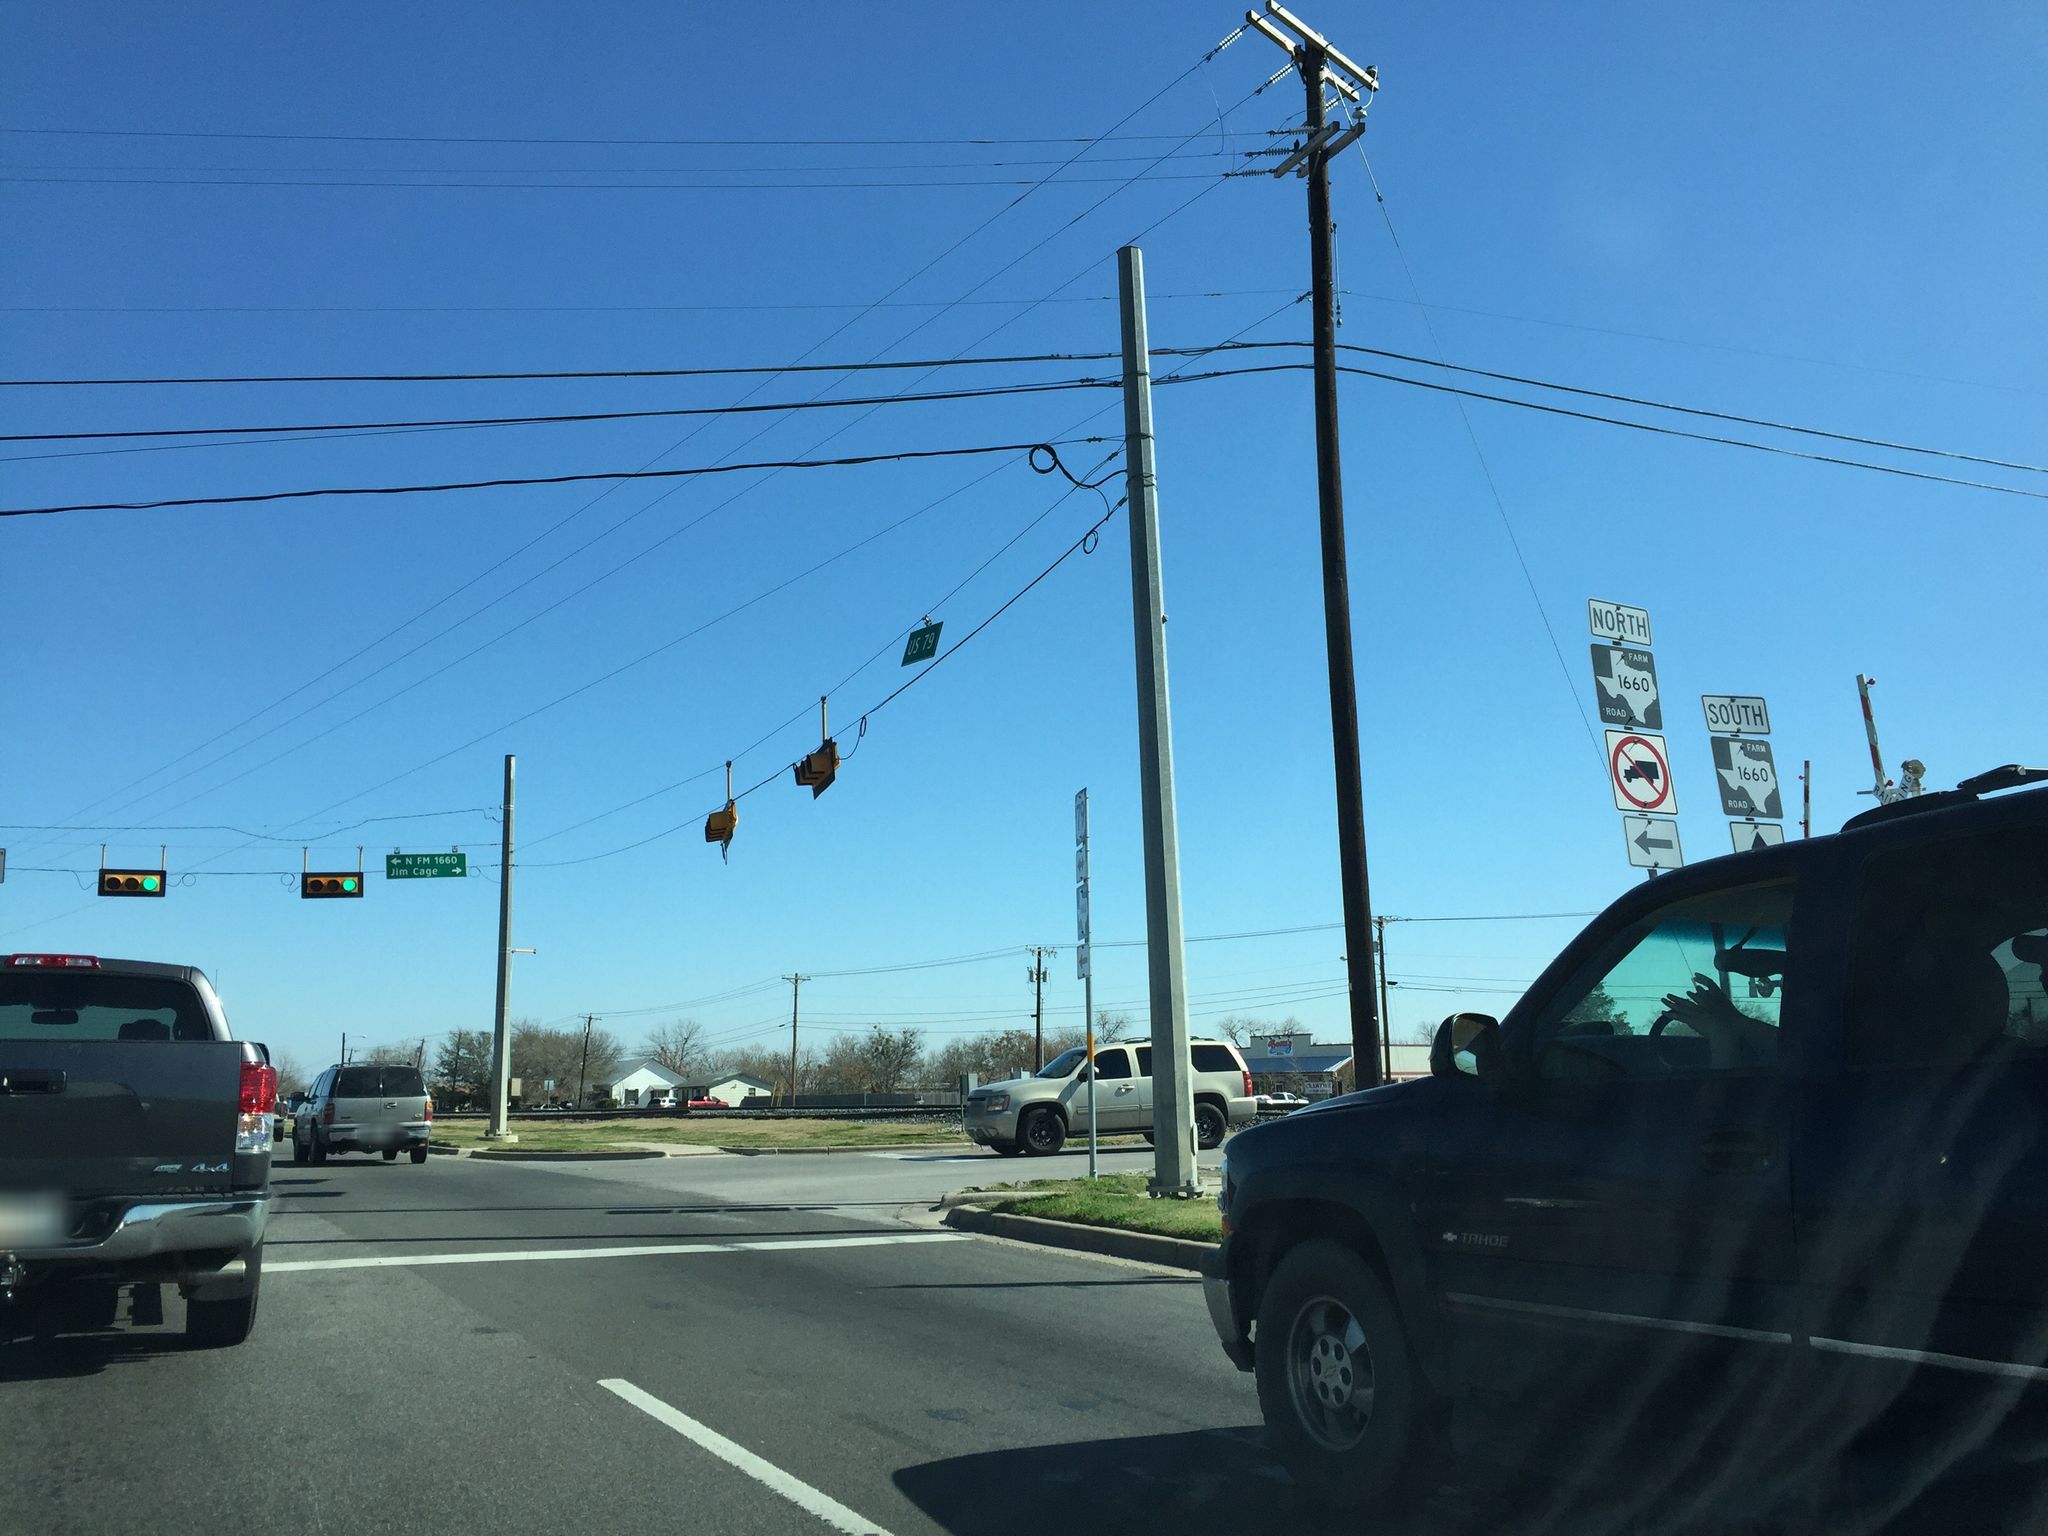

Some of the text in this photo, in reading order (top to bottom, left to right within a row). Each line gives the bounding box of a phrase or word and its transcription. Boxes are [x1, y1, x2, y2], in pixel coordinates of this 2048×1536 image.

[1593, 608, 1647, 637] NORTH
[908, 632, 935, 655] US 79
[1628, 653, 1648, 662] FARM
[1618, 675, 1649, 692] 1660
[1606, 707, 1626, 717] ROAD
[1708, 704, 1764, 726] SOUTH
[1747, 744, 1766, 753] FARM
[1738, 766, 1768, 782] 1660
[1728, 800, 1747, 809] ROAD
[405, 856, 458, 865] N FM 1660
[390, 867, 438, 877] Jim Cage
[1461, 1232, 1509, 1248] TAHOE
